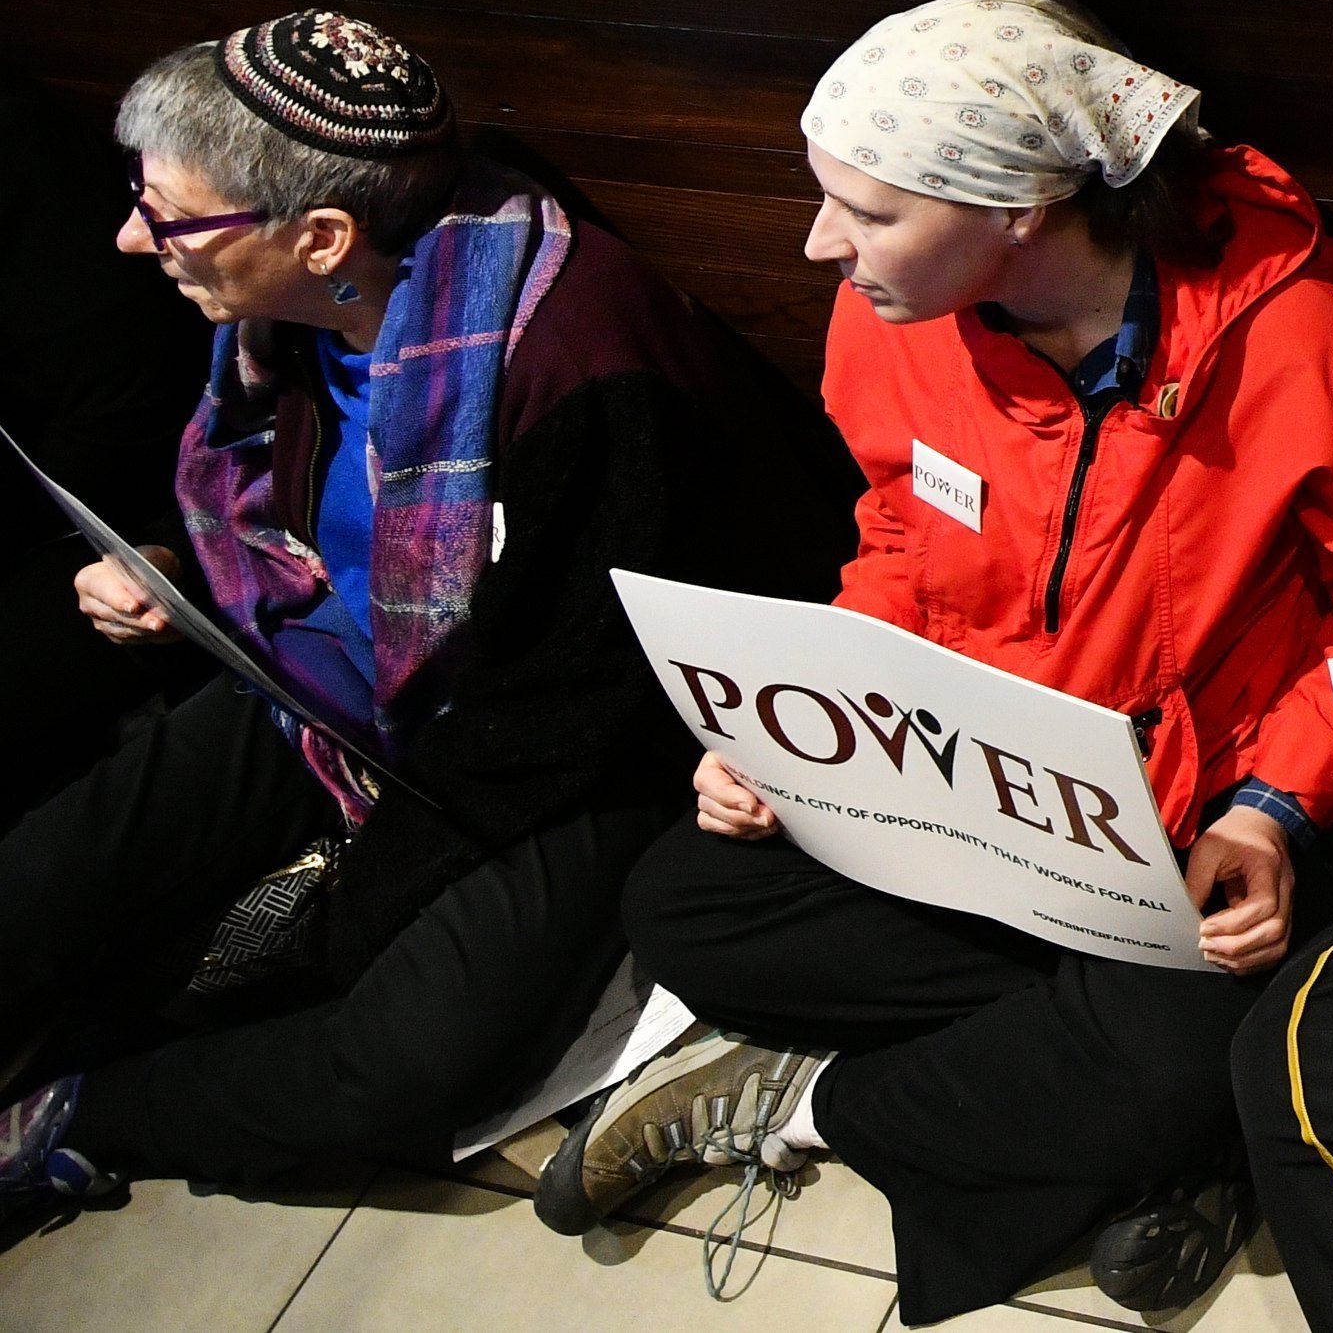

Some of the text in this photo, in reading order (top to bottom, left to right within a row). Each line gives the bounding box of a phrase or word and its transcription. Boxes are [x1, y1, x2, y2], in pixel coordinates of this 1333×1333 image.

[914, 464, 976, 513] POWER
[667, 658, 1152, 867] POWER
[794, 794, 806, 805] A
[807, 798, 843, 815] CITY
[847, 807, 870, 820] OF
[873, 812, 988, 850] OPPORTUNITY
[990, 843, 1031, 869] THAT
[1032, 863, 1096, 895] WORKS
[1098, 887, 1135, 905] FOR
[1137, 898, 1172, 913] ALL
[1032, 909, 1172, 951] POWERINTERFAITH.ORG
